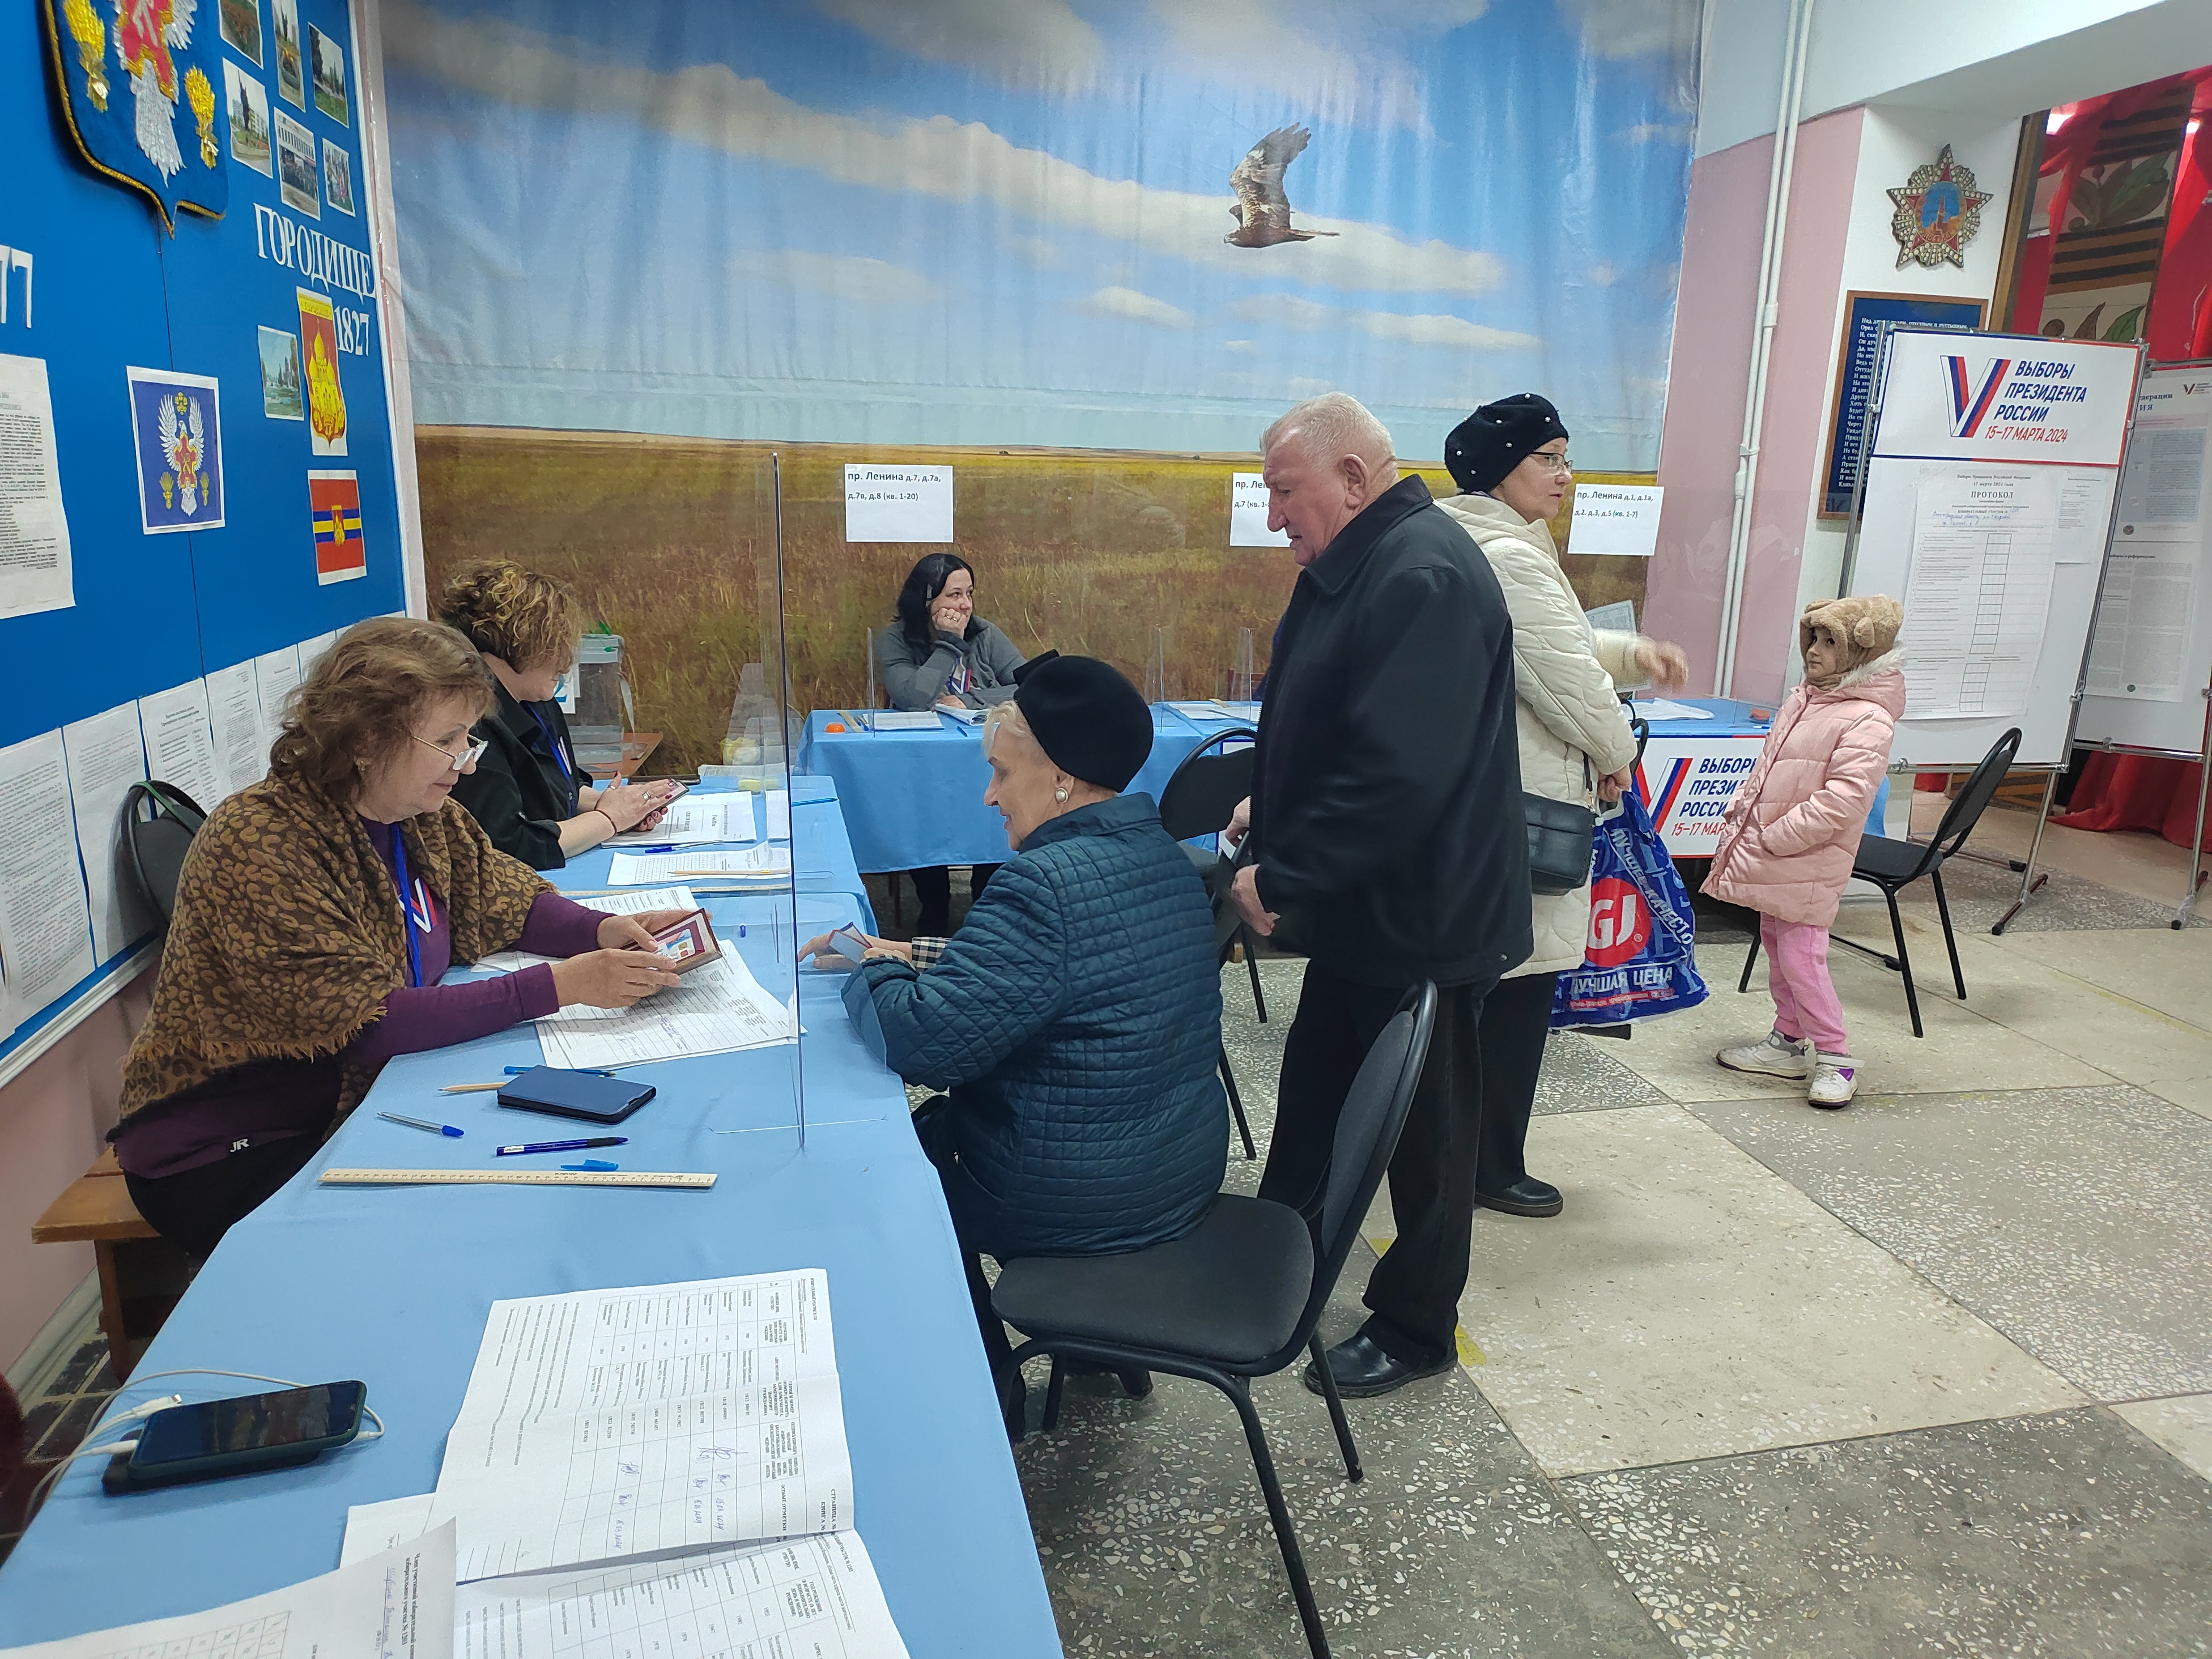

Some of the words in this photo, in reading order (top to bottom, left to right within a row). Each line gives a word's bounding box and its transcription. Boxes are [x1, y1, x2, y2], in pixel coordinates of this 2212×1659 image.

[253, 202, 376, 305] ГОРОДИЩЕ
[334, 305, 369, 356] 1827
[2015, 360, 2075, 380] ВЫБОРЫ
[2004, 382, 2087, 403] ПРЕЗИДЕНТА
[1993, 405, 2049, 422] РОССИИ
[2012, 427, 2044, 441] МАРТА
[2044, 428, 2068, 443] 2024
[848, 473, 863, 482] пр.
[866, 471, 903, 480] Ленина
[883, 492, 897, 501] (кв.
[899, 493, 918, 501] 1-20)
[1592, 491, 1622, 500] Ленина
[1247, 500, 1260, 509] (кв.
[1688, 780, 1745, 796] ПРЕЗИ
[1679, 802, 1728, 817] РОССИ
[1701, 822, 1727, 836] МАР
[1588, 894, 1637, 950] GJ
[1634, 967, 1673, 988] ЦЕНА
[230, 1138, 249, 1152] JR
